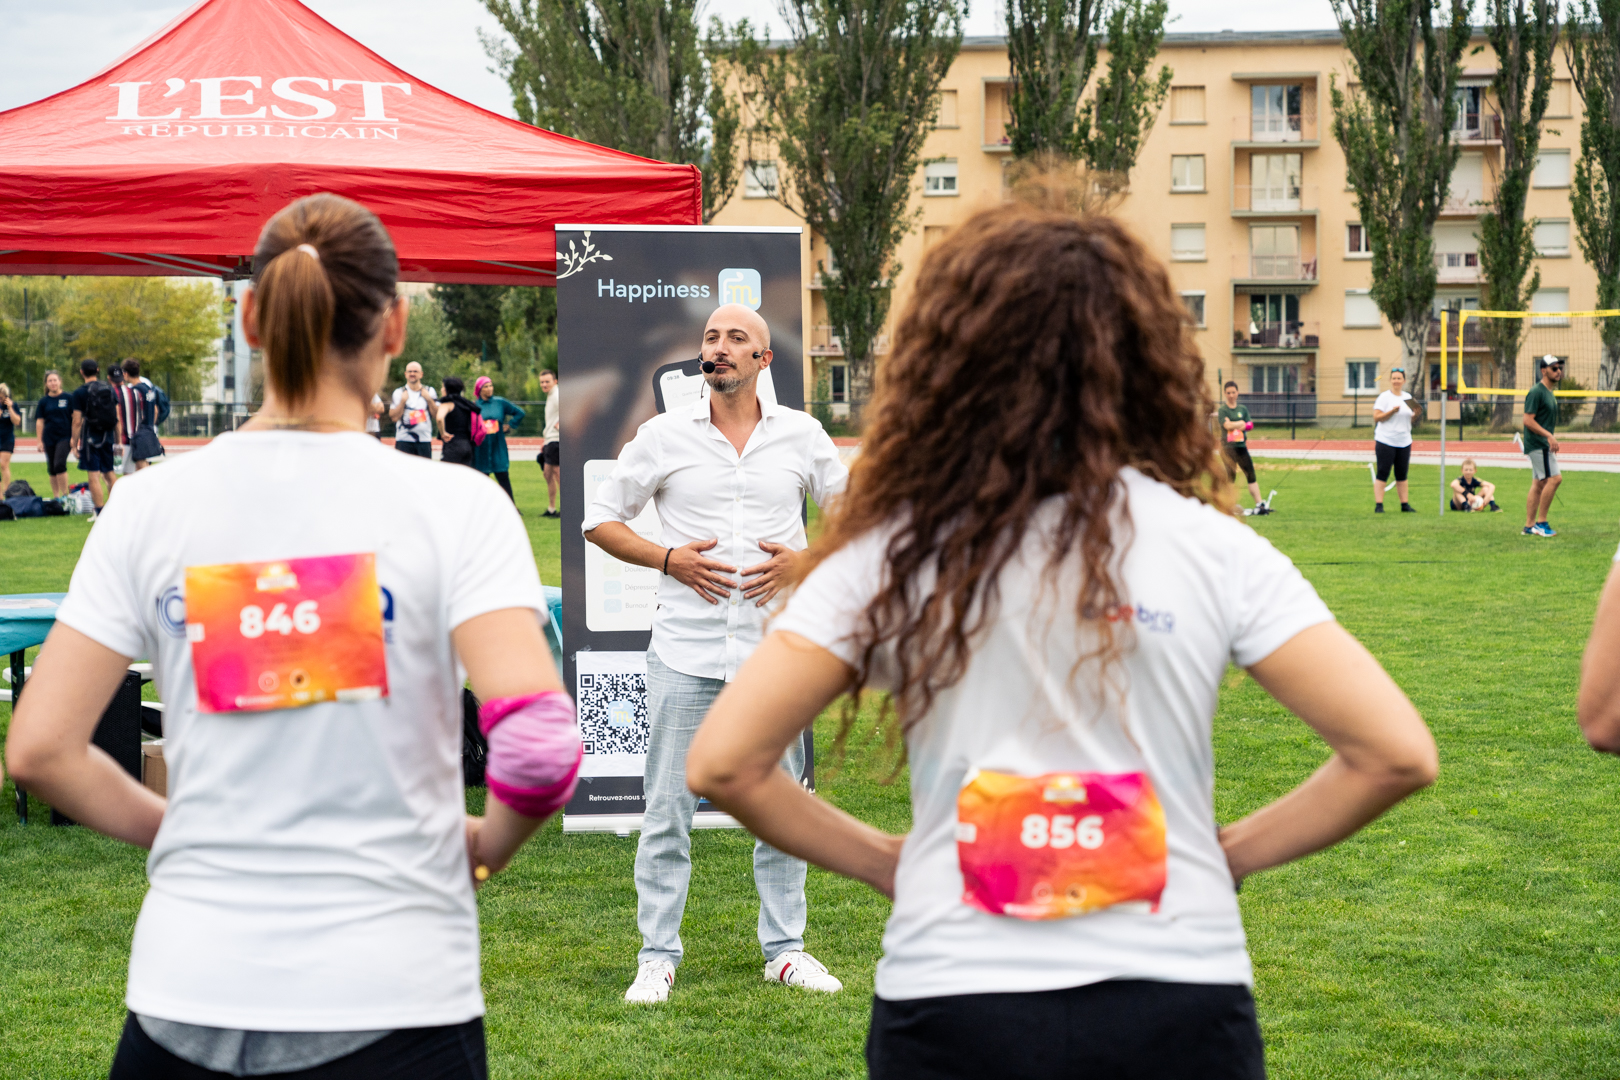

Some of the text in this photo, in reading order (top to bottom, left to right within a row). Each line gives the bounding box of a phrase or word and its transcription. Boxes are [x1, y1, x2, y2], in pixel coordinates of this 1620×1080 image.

[105, 76, 412, 122] L'EST
[598, 278, 711, 303] Happiness
[239, 600, 321, 639] 846
[588, 794, 640, 802] Retrouvez-nous
[1020, 814, 1104, 849] 856
